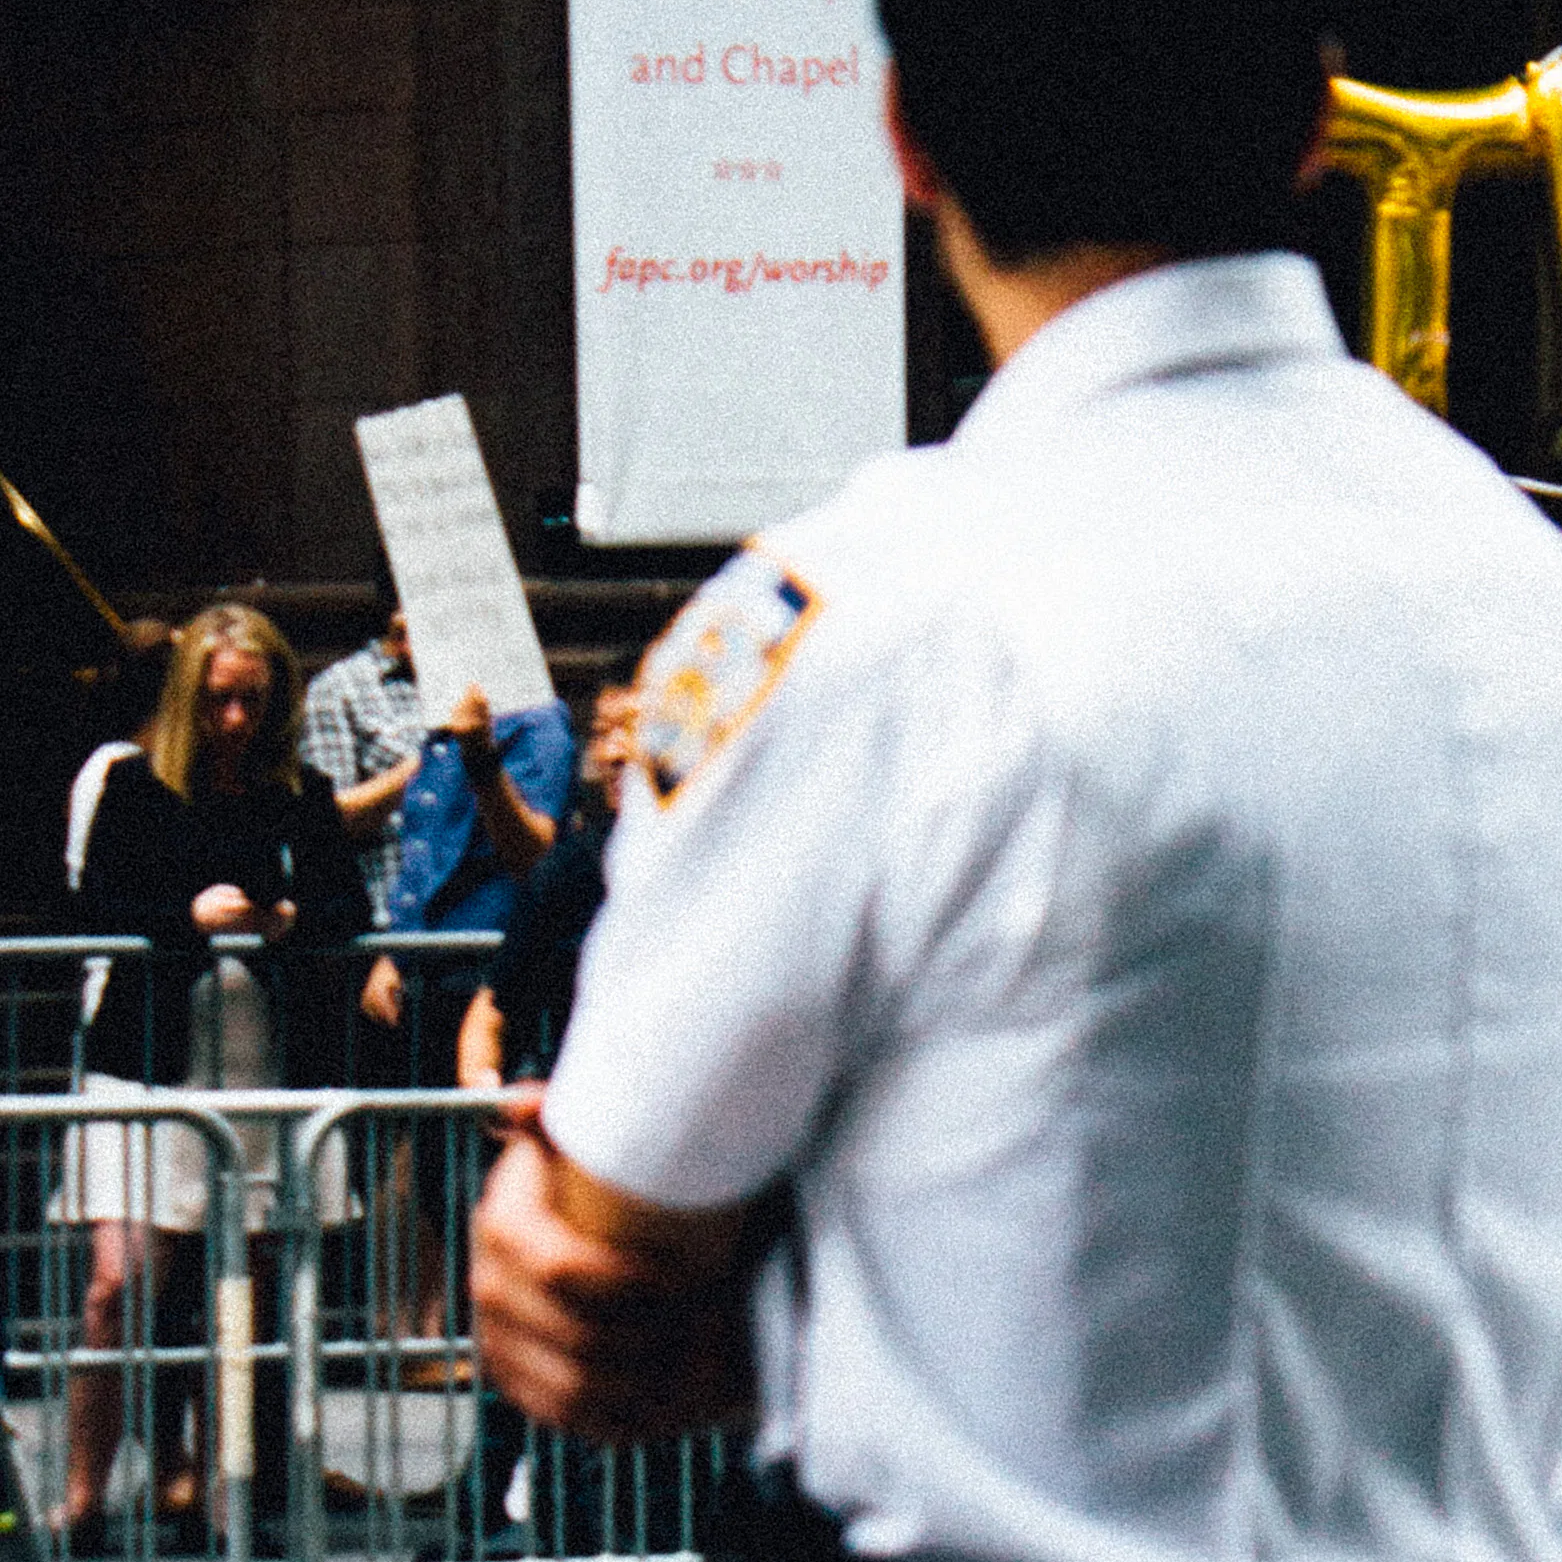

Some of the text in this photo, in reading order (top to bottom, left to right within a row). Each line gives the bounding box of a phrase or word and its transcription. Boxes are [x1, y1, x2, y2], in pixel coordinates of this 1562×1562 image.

[630, 44, 858, 94] and Chapel
[599, 246, 889, 294] fapc.org/worship
